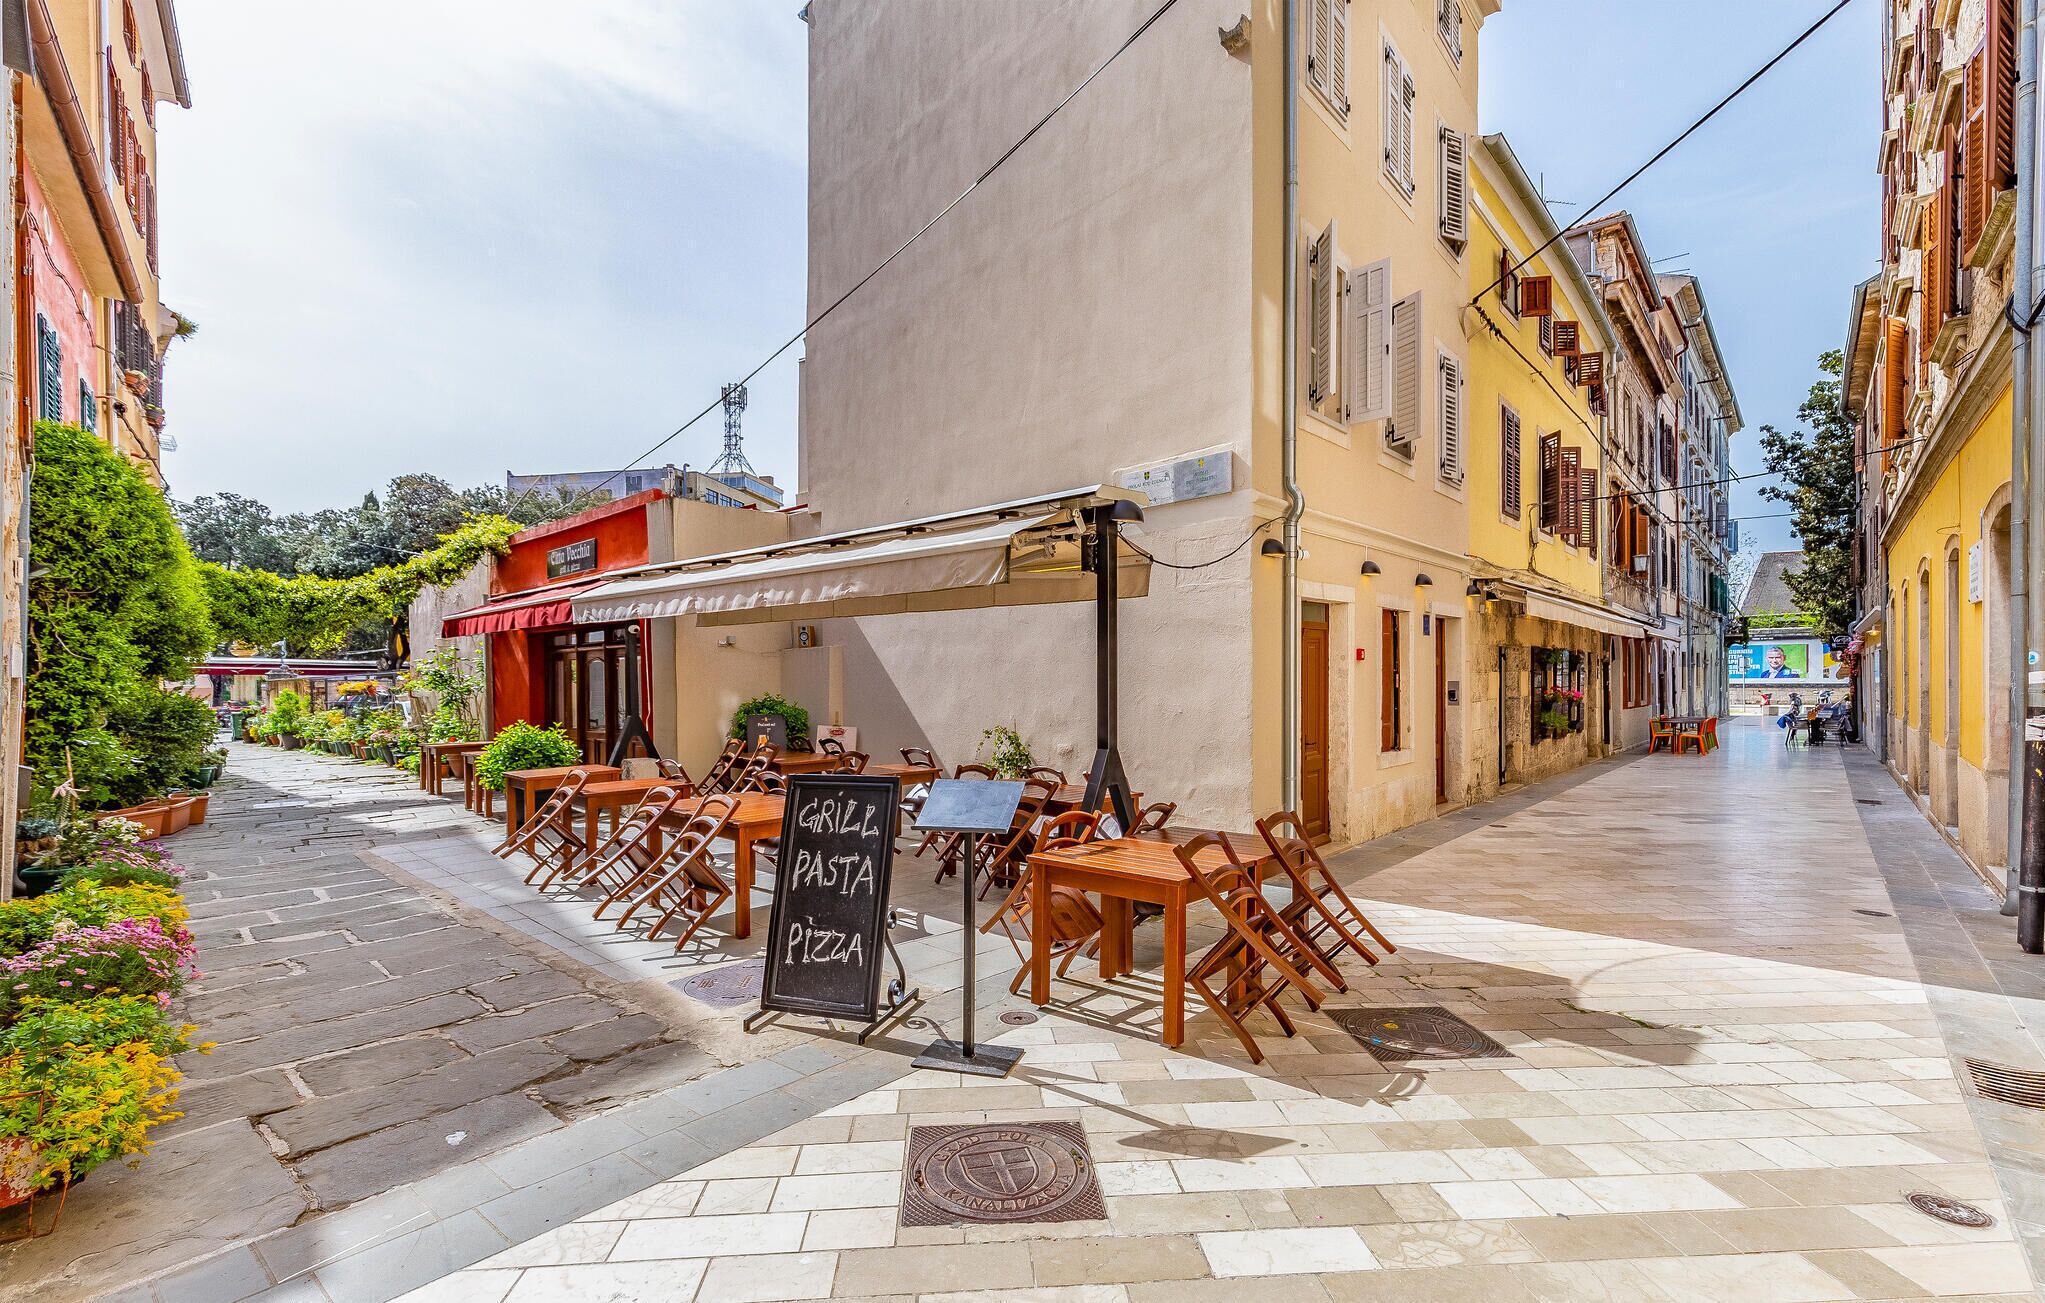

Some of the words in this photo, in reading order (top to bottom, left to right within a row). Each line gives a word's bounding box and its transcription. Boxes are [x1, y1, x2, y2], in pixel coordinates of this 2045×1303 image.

[567, 544, 590, 561] Vecchia
[799, 791, 880, 839] GRILL
[791, 849, 874, 898] PASTA
[785, 915, 863, 967] PIZZA
[933, 1135, 981, 1162] GRAD
[996, 1131, 1046, 1149] PULA
